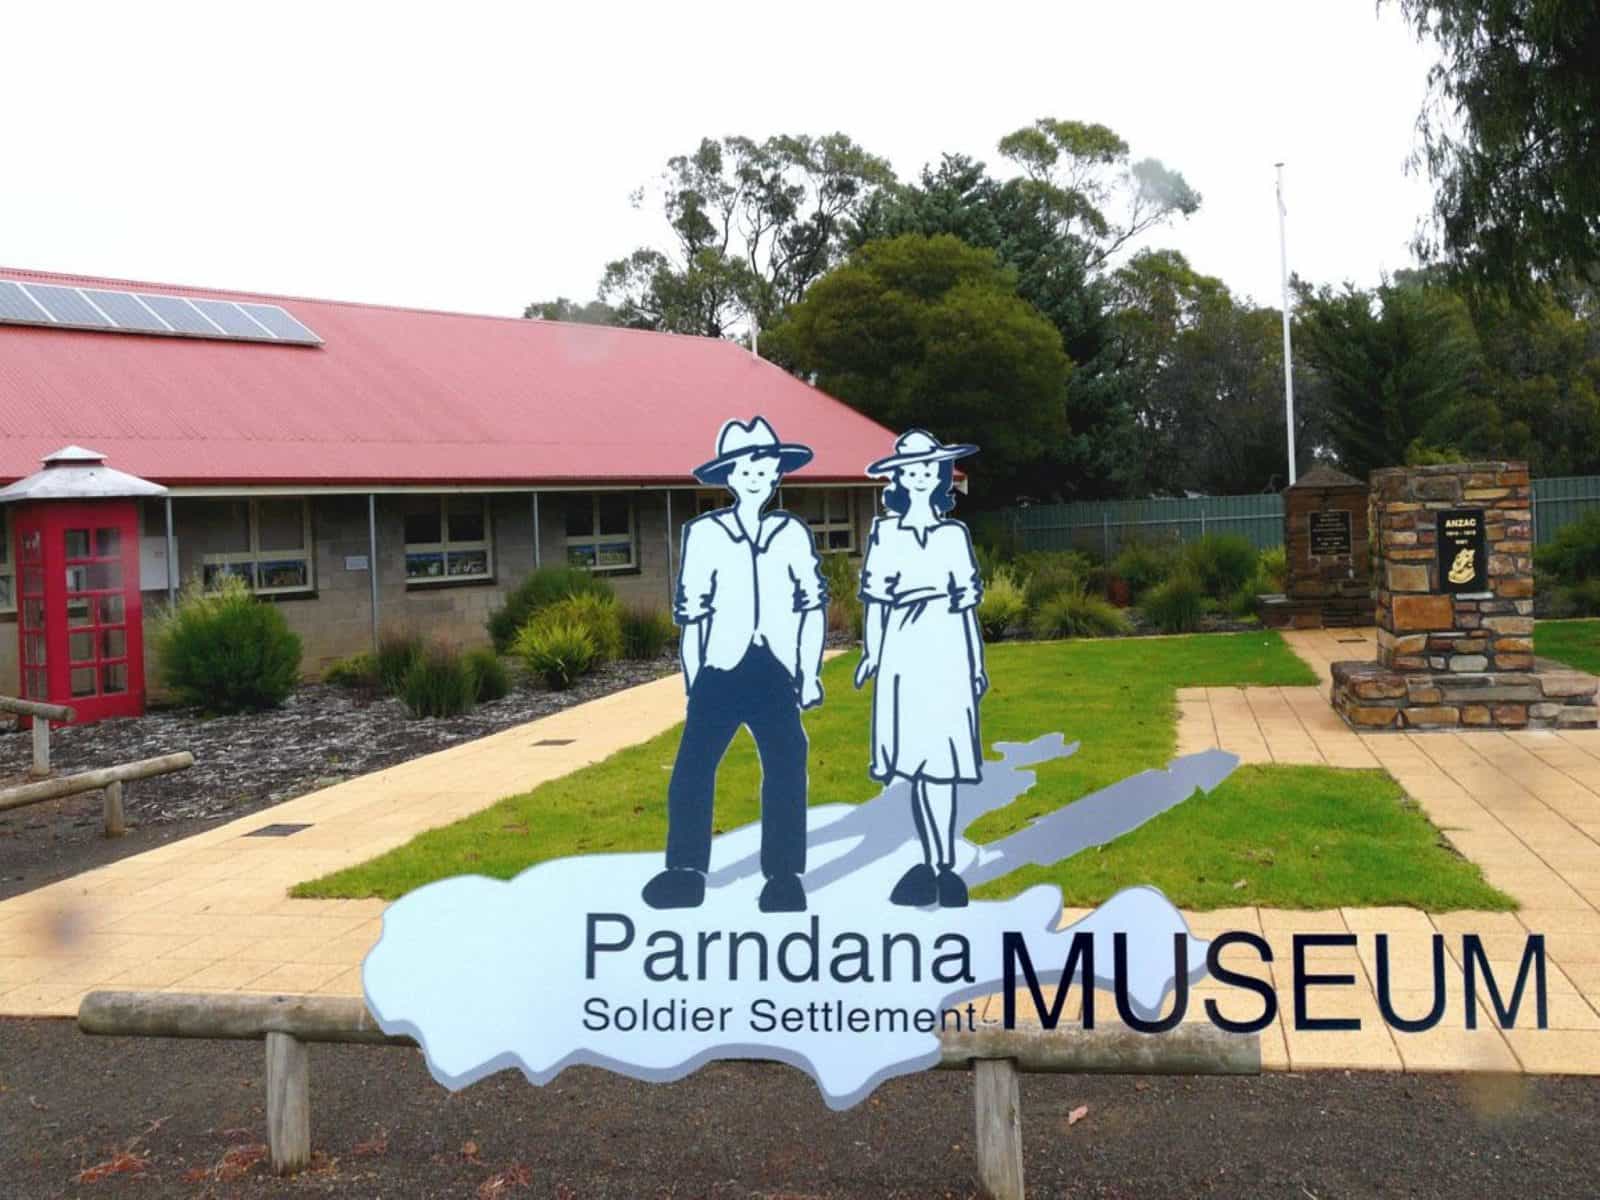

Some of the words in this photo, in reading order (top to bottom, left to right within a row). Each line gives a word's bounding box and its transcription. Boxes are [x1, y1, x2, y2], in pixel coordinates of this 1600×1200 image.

[1445, 518, 1477, 528] ANZAC
[586, 912, 977, 984] Parndana
[1002, 931, 1549, 1034] MUSEUM
[583, 997, 733, 1032] Soldier
[749, 998, 977, 1033] Settlement
